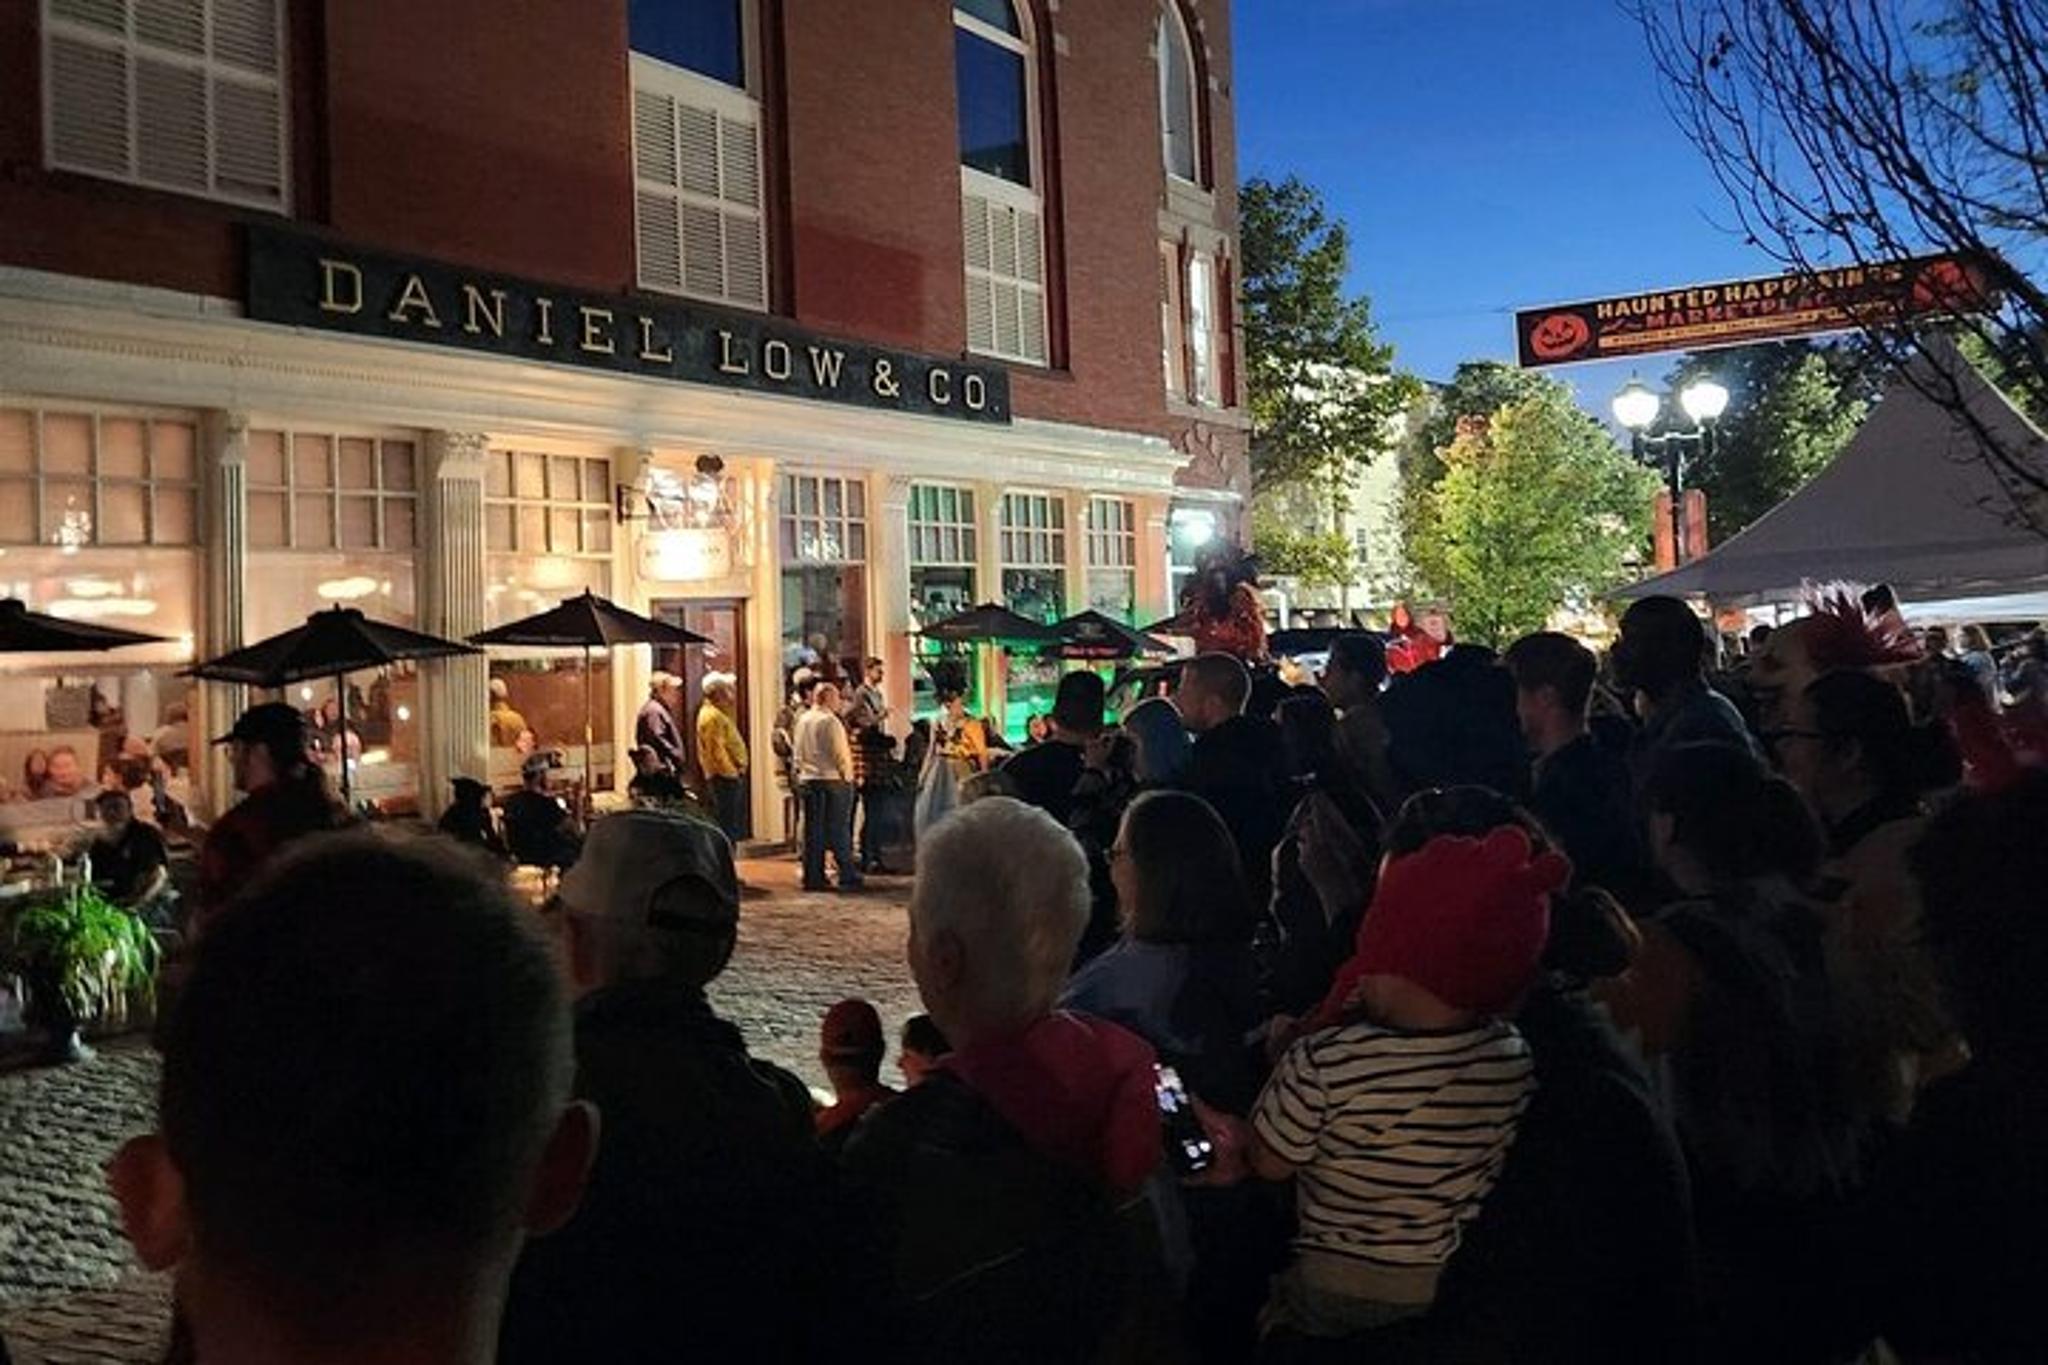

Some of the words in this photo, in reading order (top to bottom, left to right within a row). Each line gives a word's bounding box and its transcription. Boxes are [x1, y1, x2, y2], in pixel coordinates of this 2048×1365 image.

[319, 258, 673, 363] DANIEL
[718, 330, 846, 388] LOW
[873, 359, 900, 397] &
[928, 368, 999, 413] CO.
[1597, 289, 1718, 318] HAUNTED
